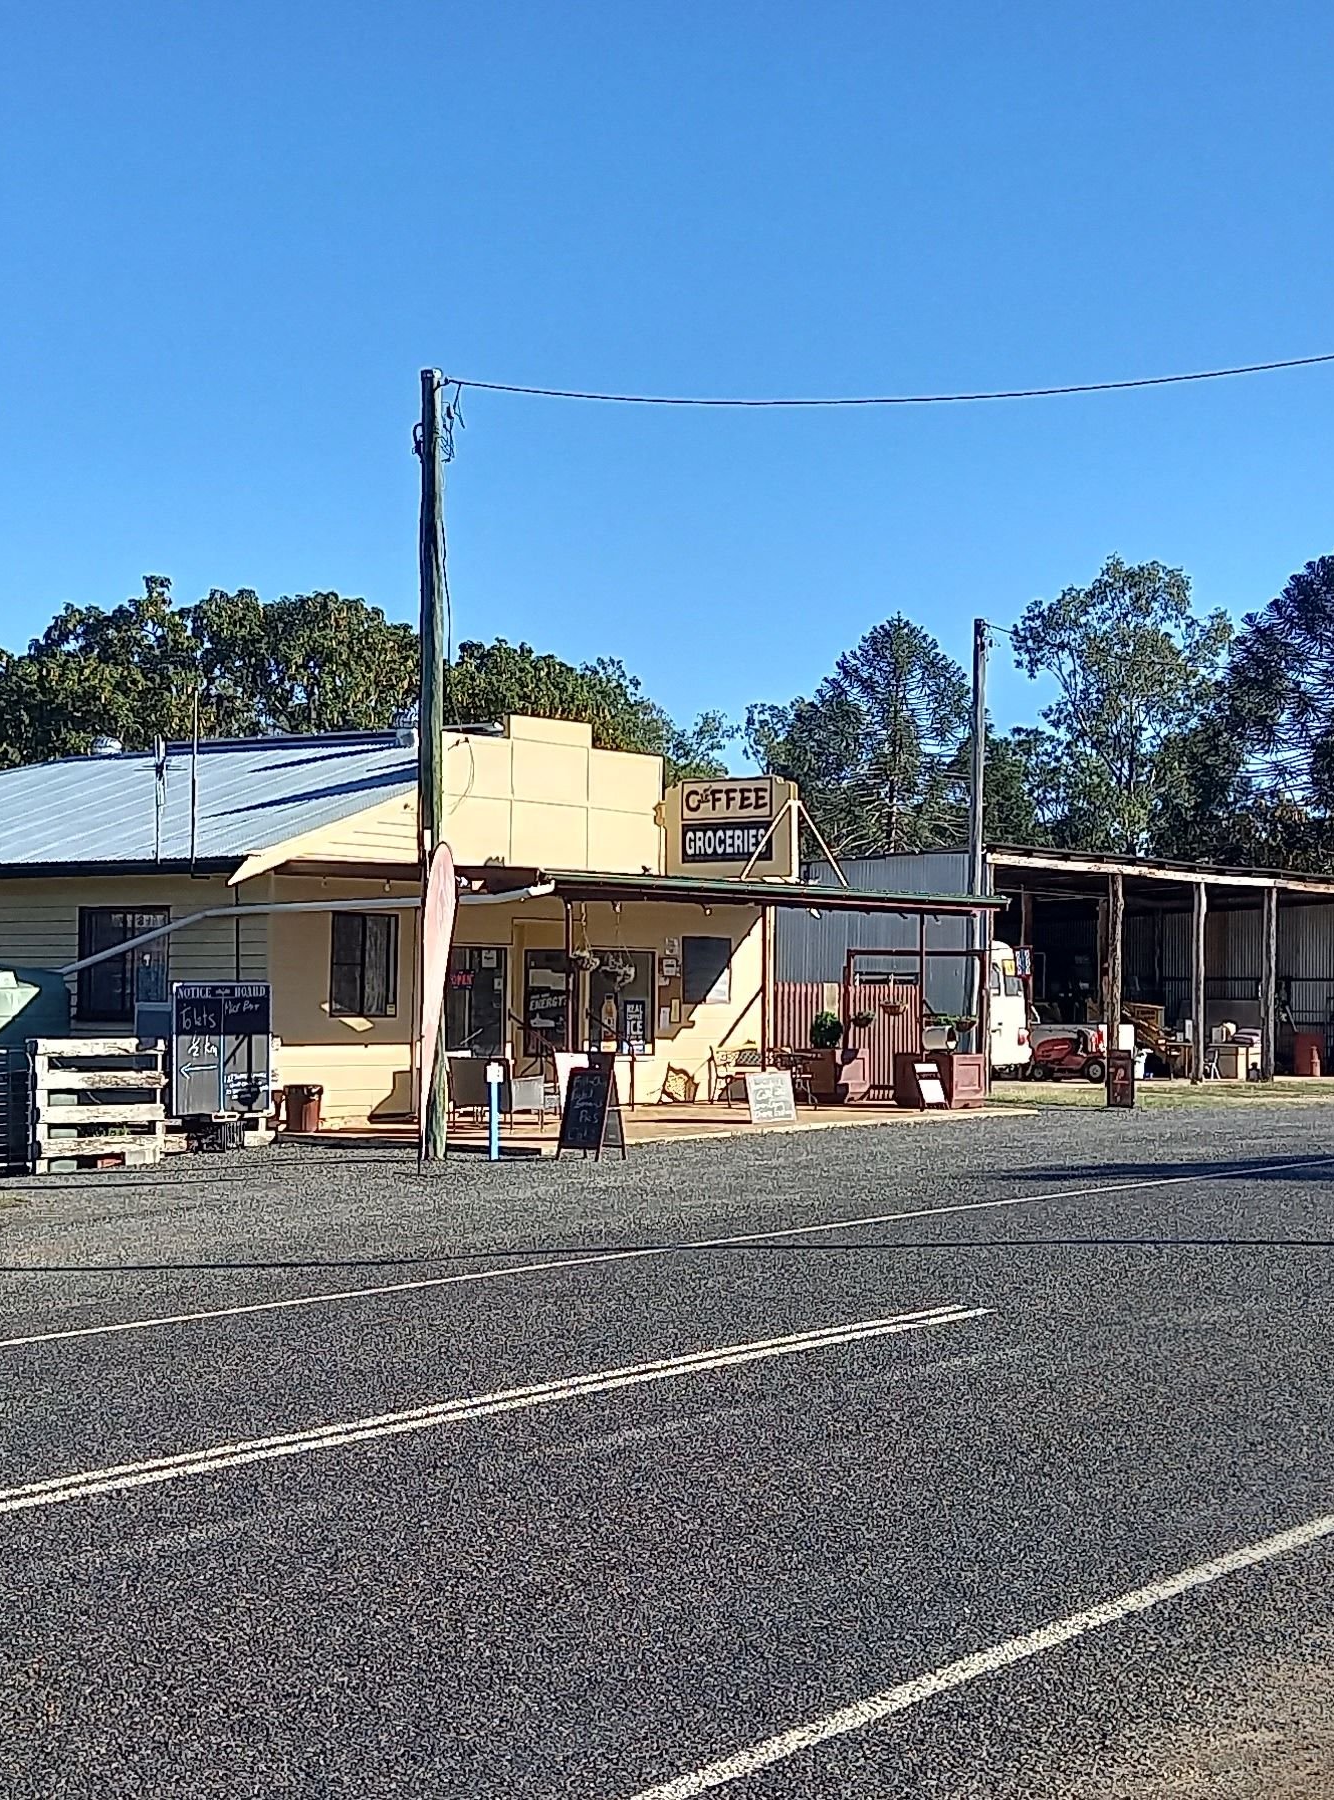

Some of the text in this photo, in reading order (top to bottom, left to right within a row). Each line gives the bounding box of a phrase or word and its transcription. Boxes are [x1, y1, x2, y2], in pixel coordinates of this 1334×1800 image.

[685, 828, 767, 855] GROCERIES
[177, 986, 267, 999] NOTICE BOARD
